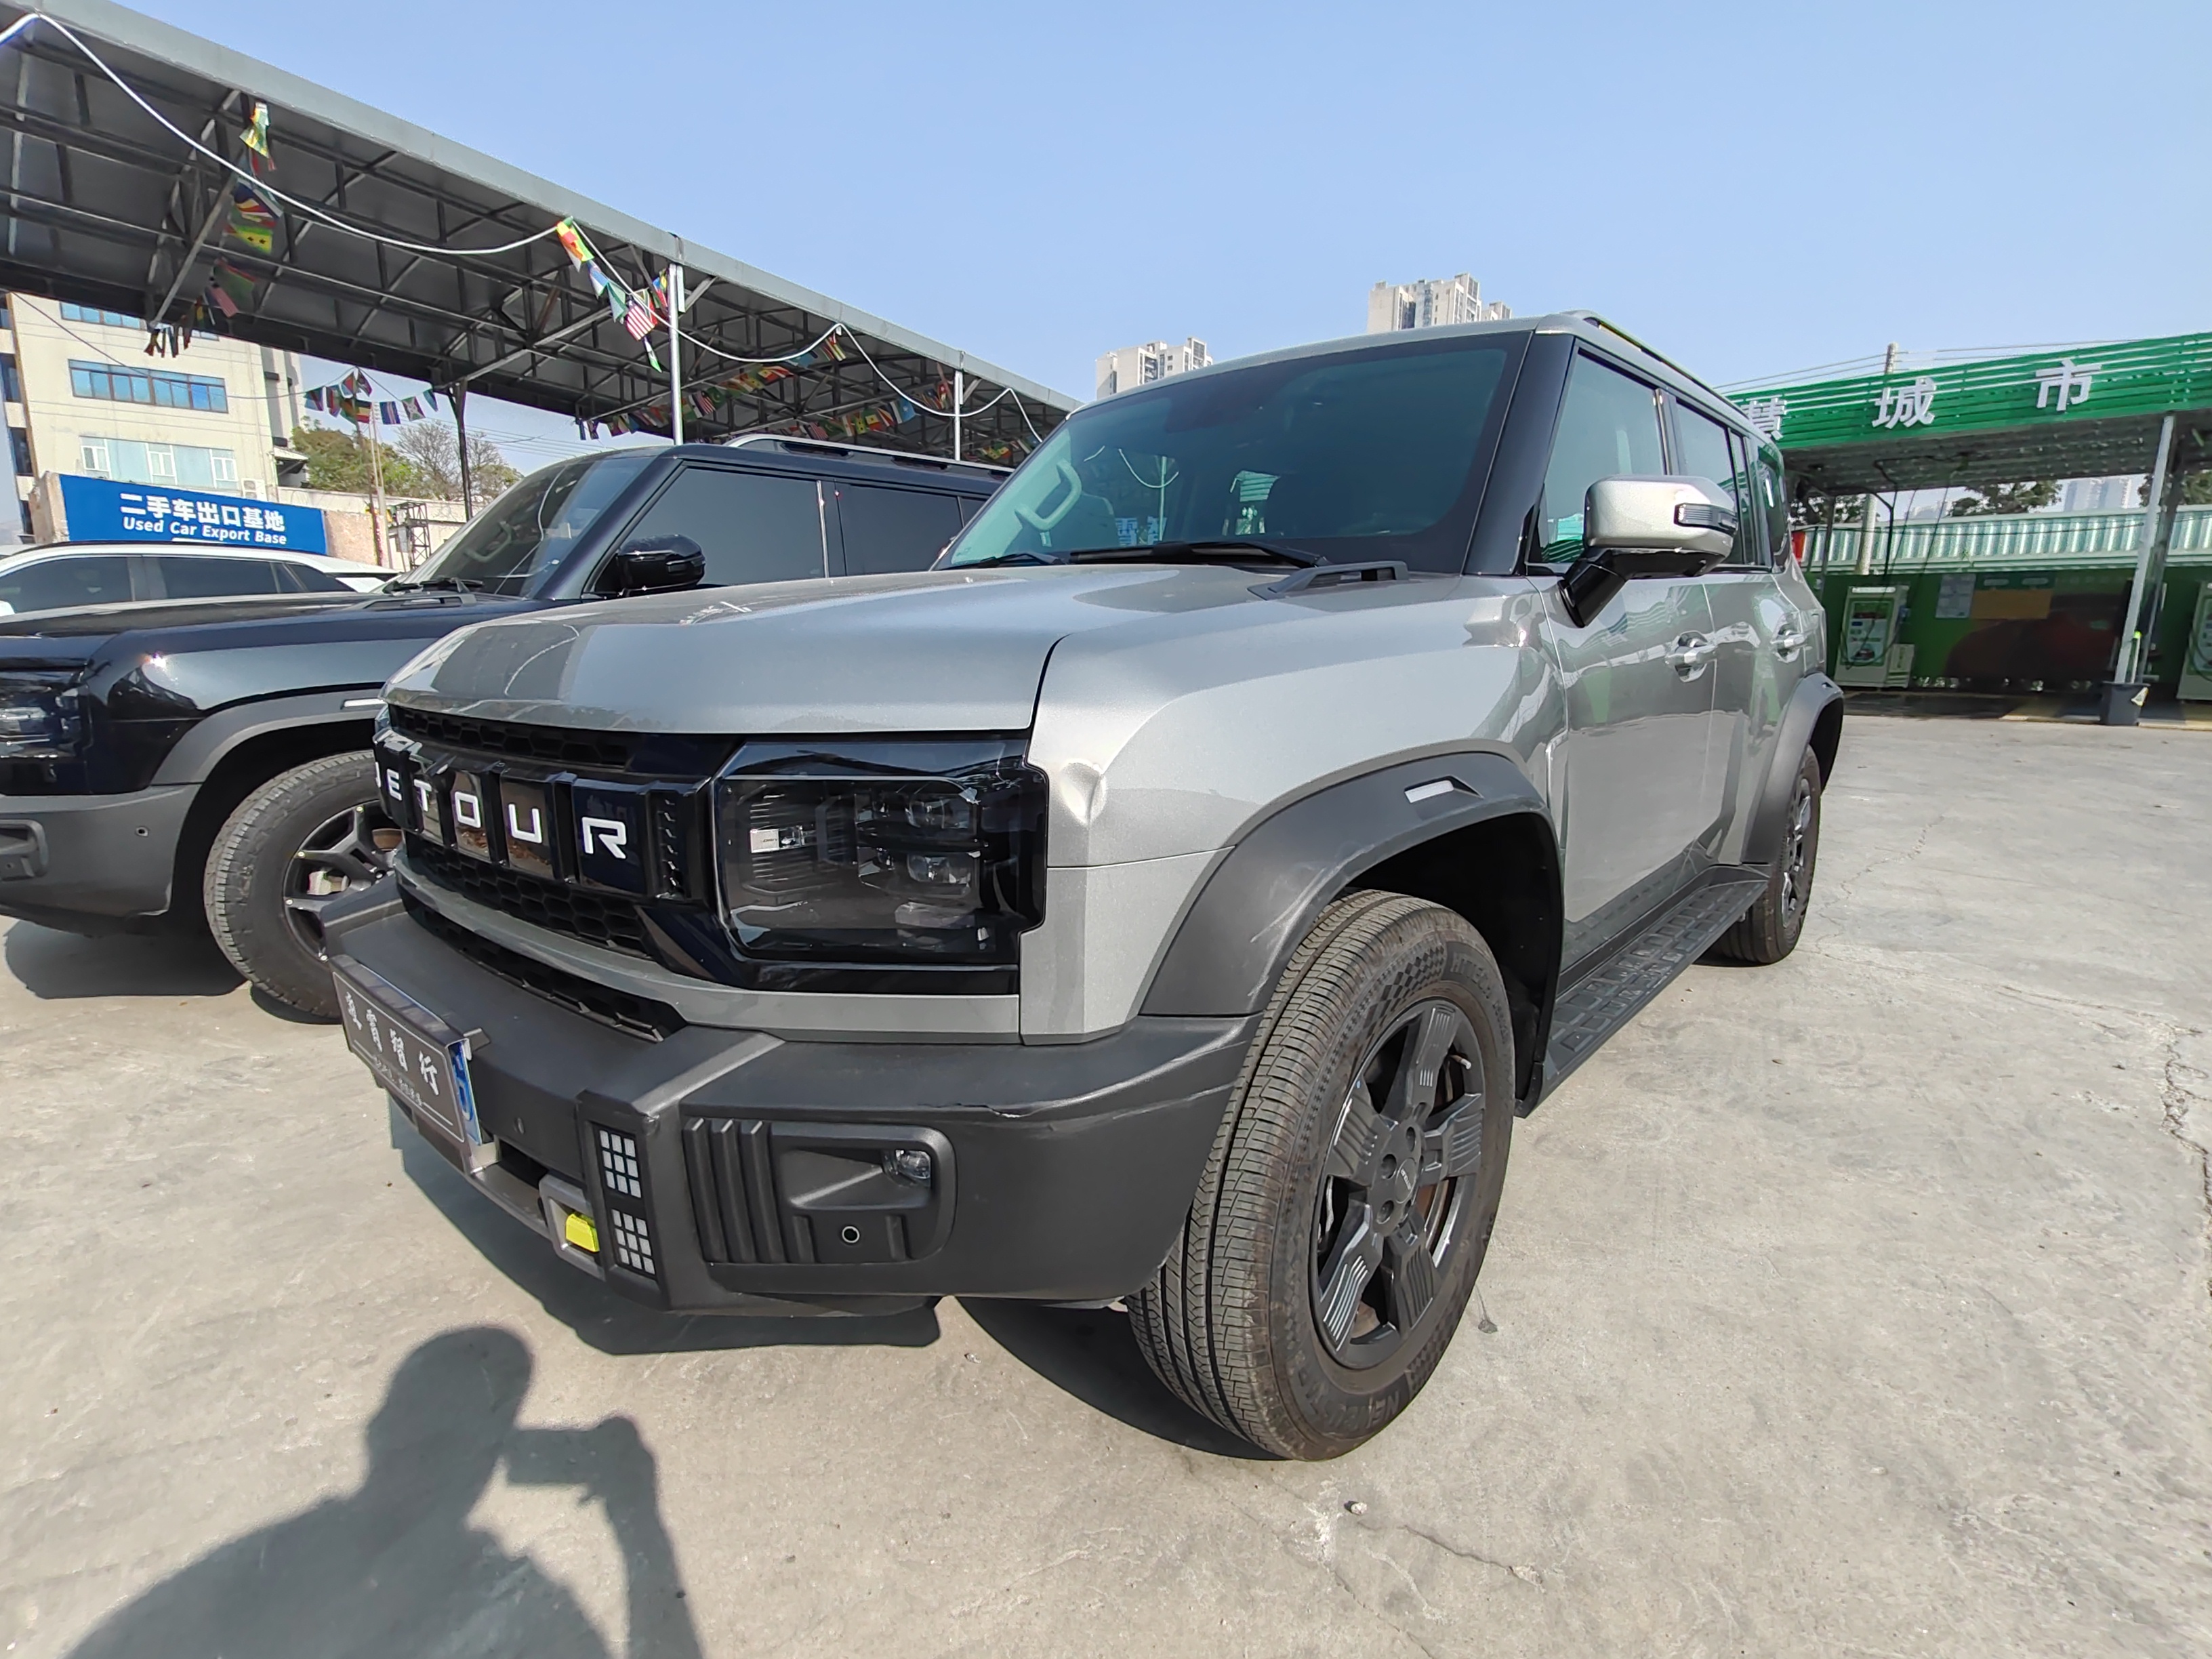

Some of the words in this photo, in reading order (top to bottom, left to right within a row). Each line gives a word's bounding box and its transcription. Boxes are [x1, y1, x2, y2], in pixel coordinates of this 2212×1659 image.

[120, 493, 285, 532] 二手车出口基地
[123, 516, 163, 533] Used
[170, 522, 197, 535] Car
[201, 525, 250, 541] Export
[255, 531, 287, 544] Base
